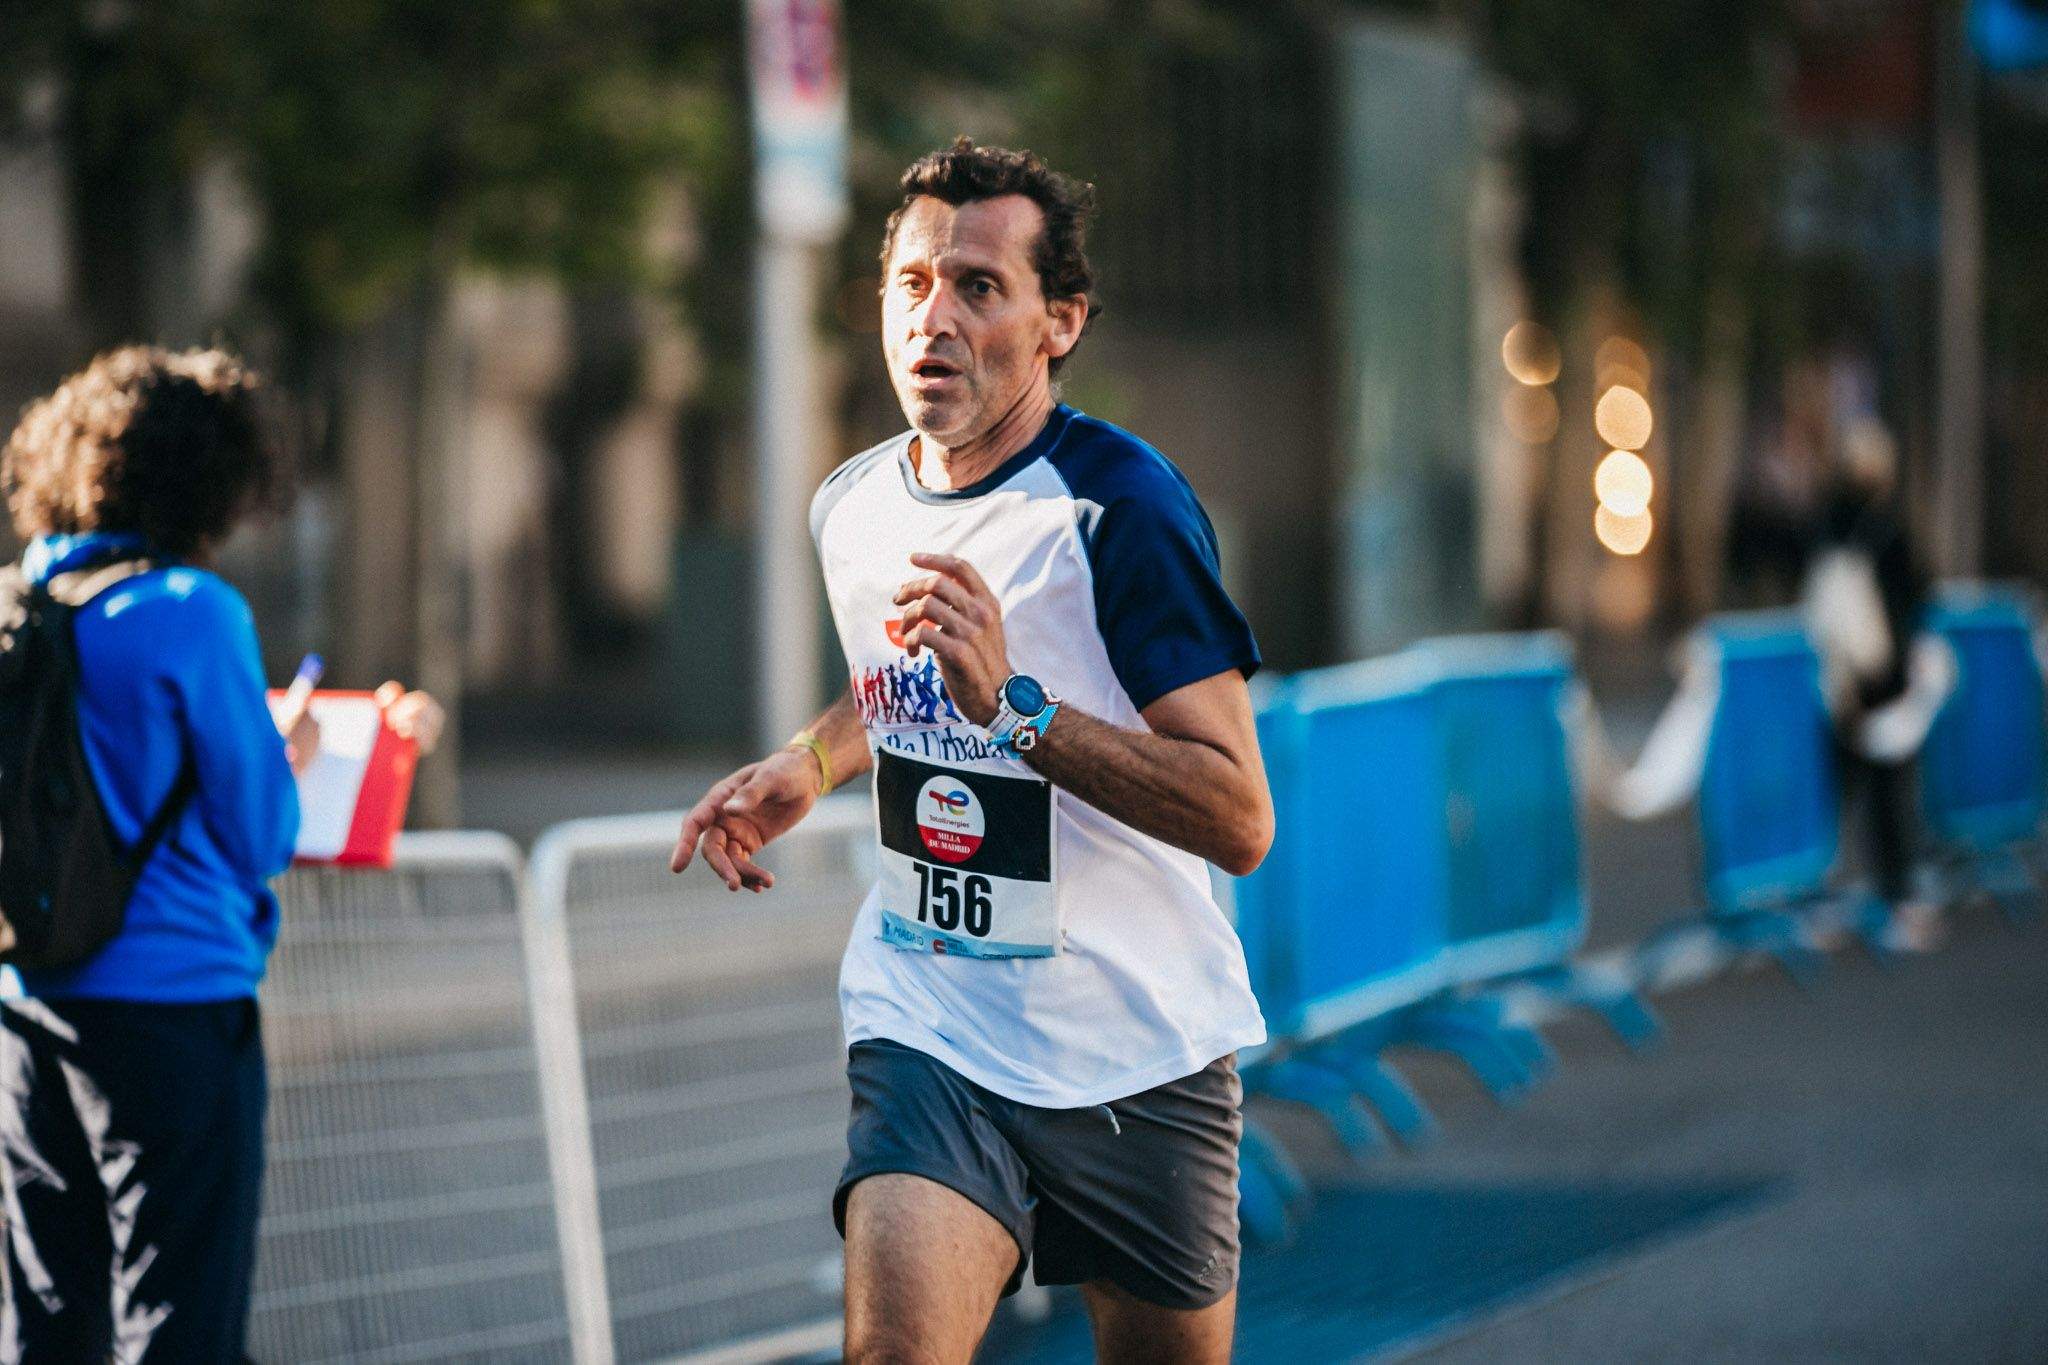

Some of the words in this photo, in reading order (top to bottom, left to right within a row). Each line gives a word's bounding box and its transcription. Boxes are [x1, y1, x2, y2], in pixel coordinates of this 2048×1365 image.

[929, 815, 970, 828] TotalEnergies
[938, 832, 961, 843] MILLA
[928, 839, 940, 848] DE
[941, 842, 970, 854] MADRID
[913, 861, 992, 938] 756
